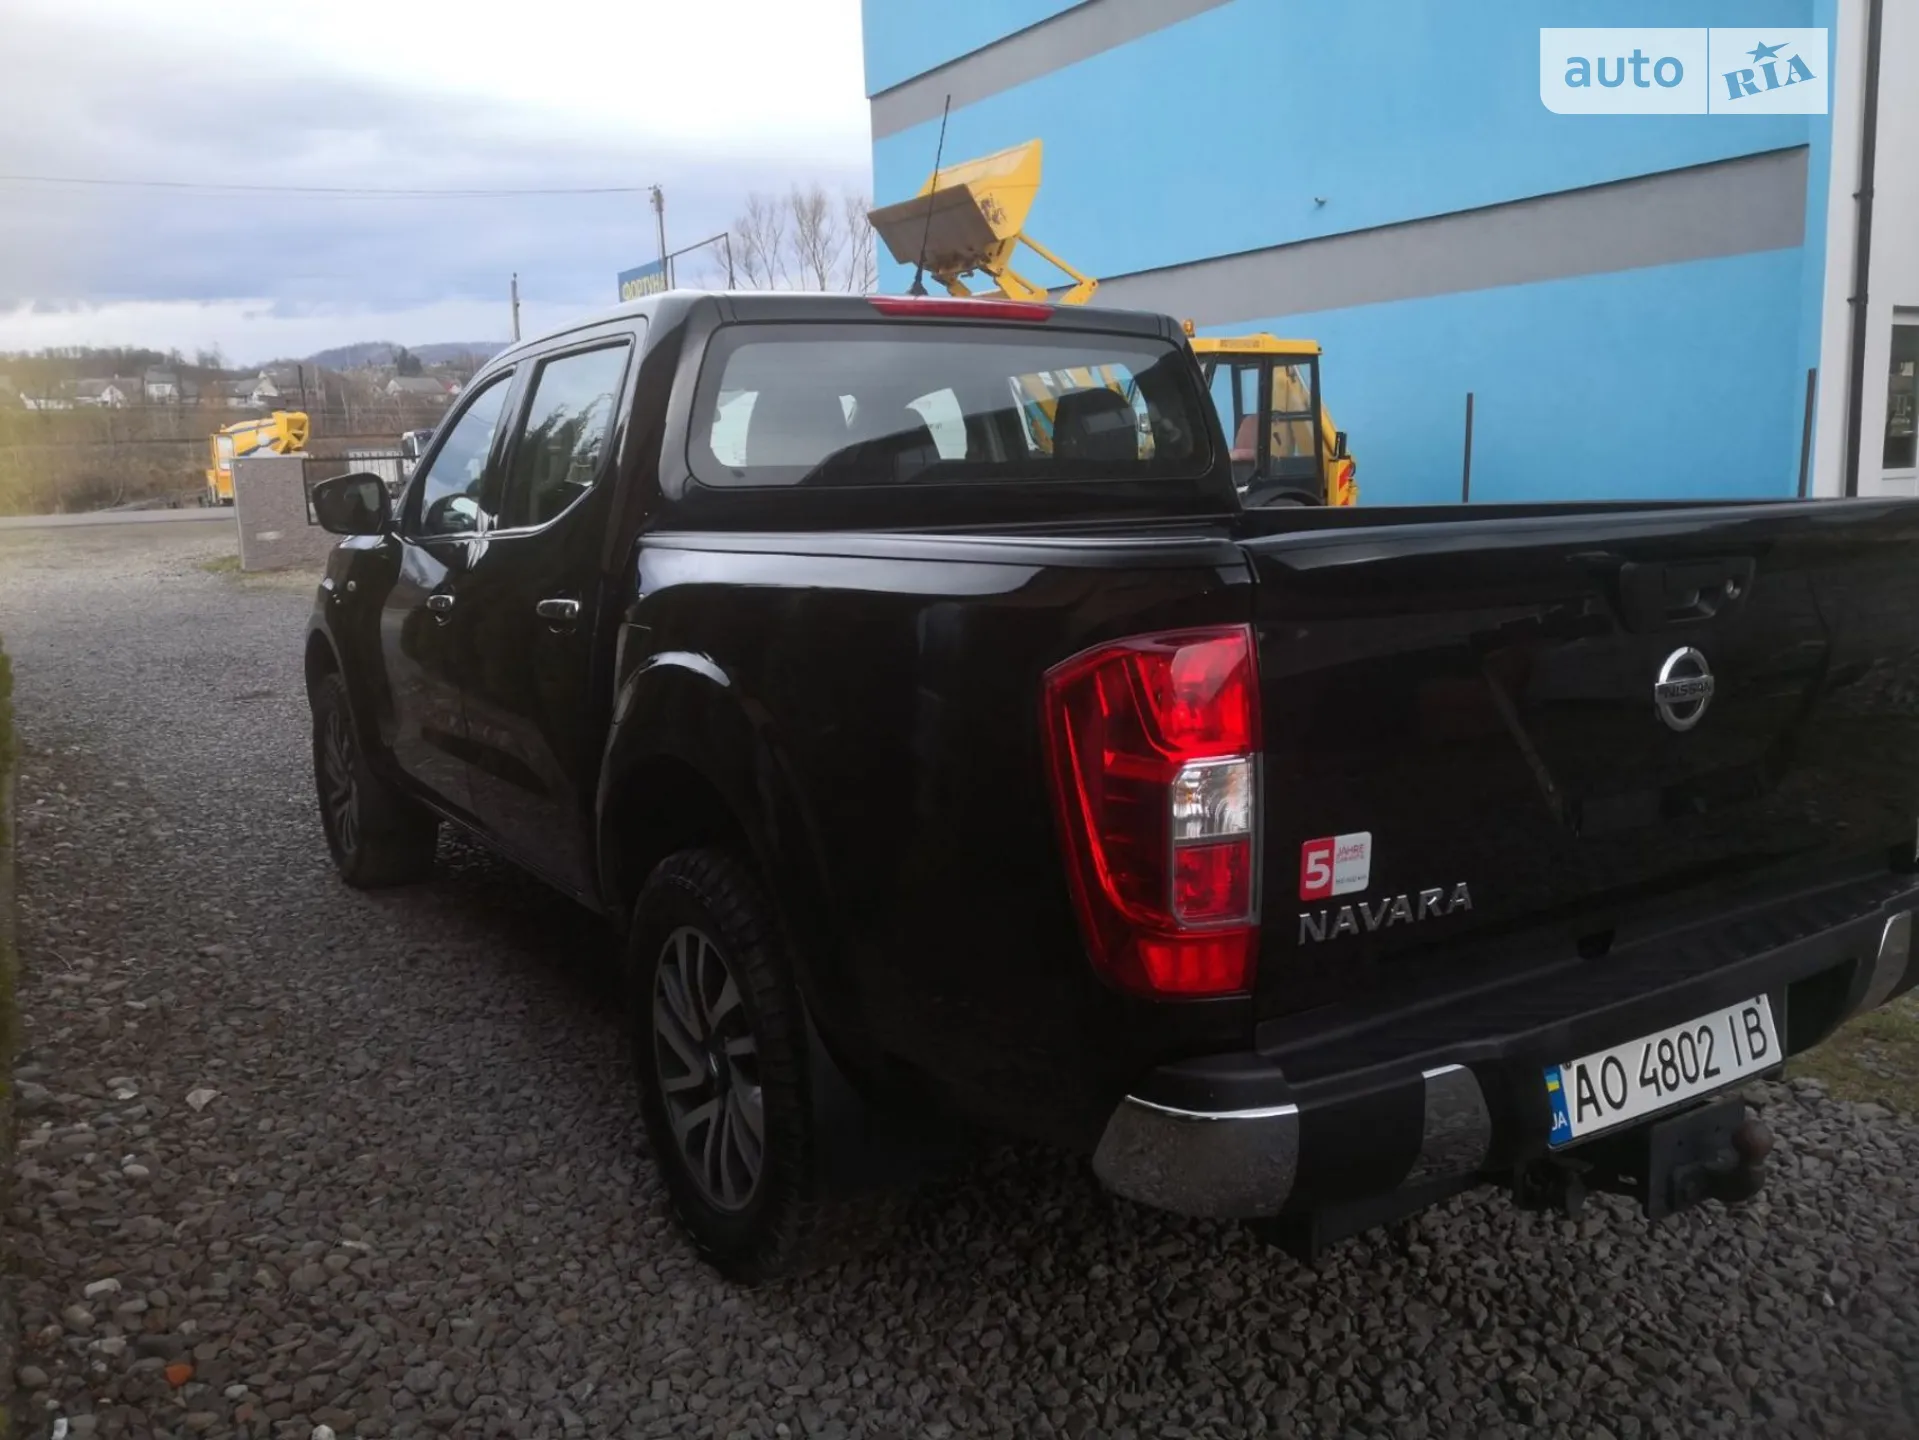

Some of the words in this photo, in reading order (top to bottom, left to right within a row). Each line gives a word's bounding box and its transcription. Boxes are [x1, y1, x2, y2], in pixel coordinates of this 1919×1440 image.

[1305, 849, 1331, 890] 5
[1298, 882, 1473, 946] NAVARA
[1573, 1055, 1628, 1124] AO
[1638, 1025, 1721, 1097] 4802
[1728, 1007, 1768, 1067] IB
